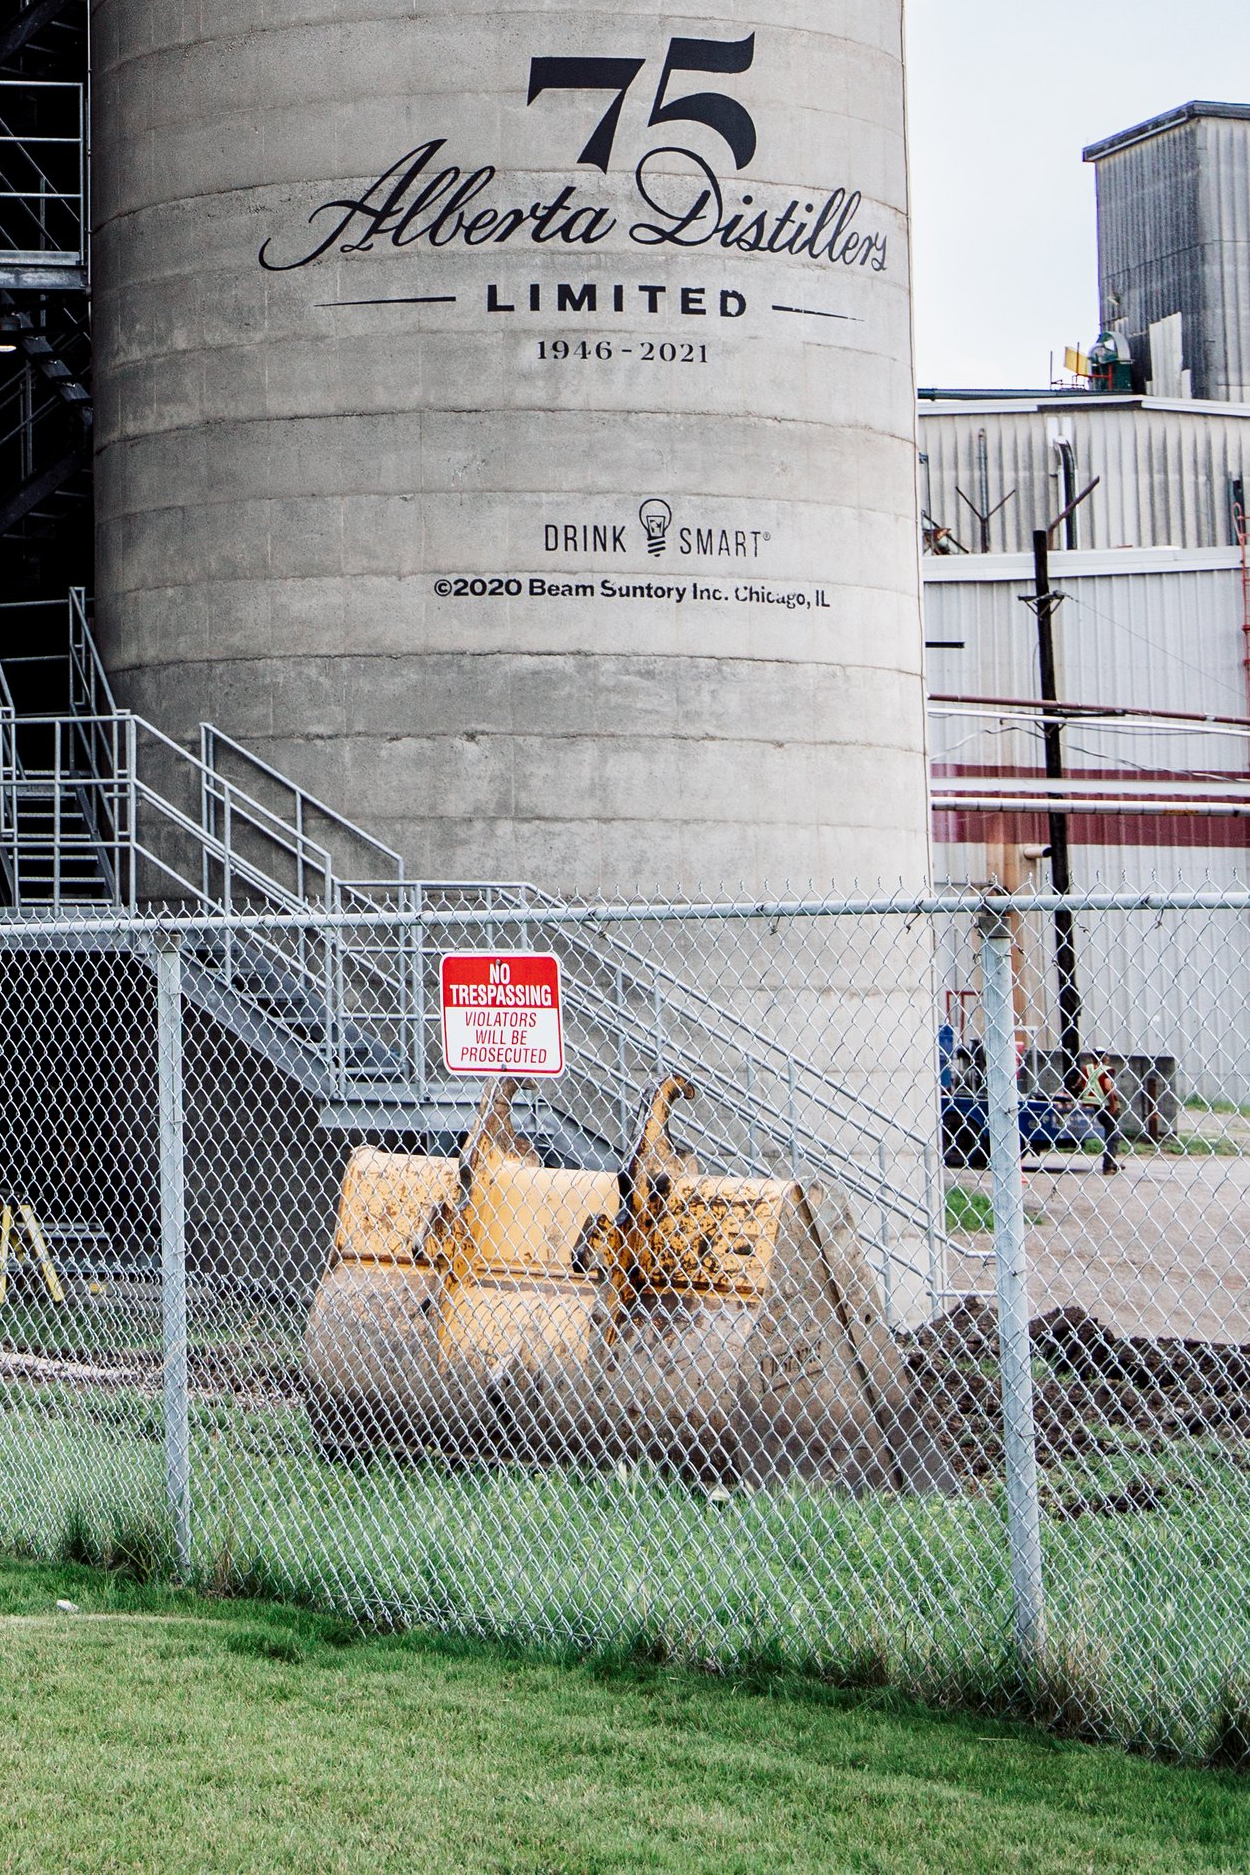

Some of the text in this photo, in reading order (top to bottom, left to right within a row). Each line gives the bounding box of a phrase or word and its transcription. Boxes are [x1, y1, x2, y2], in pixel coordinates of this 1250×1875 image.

[527, 31, 757, 176] 75
[258, 138, 887, 273] Alberta Distillers
[486, 283, 748, 319] LIMITED
[544, 524, 627, 553] DRINK
[433, 578, 831, 610] ©2020 Beam Suntory Inc. Chicago, IL
[489, 962, 511, 985] NO
[449, 984, 552, 1006] TRESPASSING
[464, 1011, 537, 1027] VIOLATORS
[475, 1029, 528, 1045] WILL BE
[460, 1046, 548, 1064] PROSECUTED
